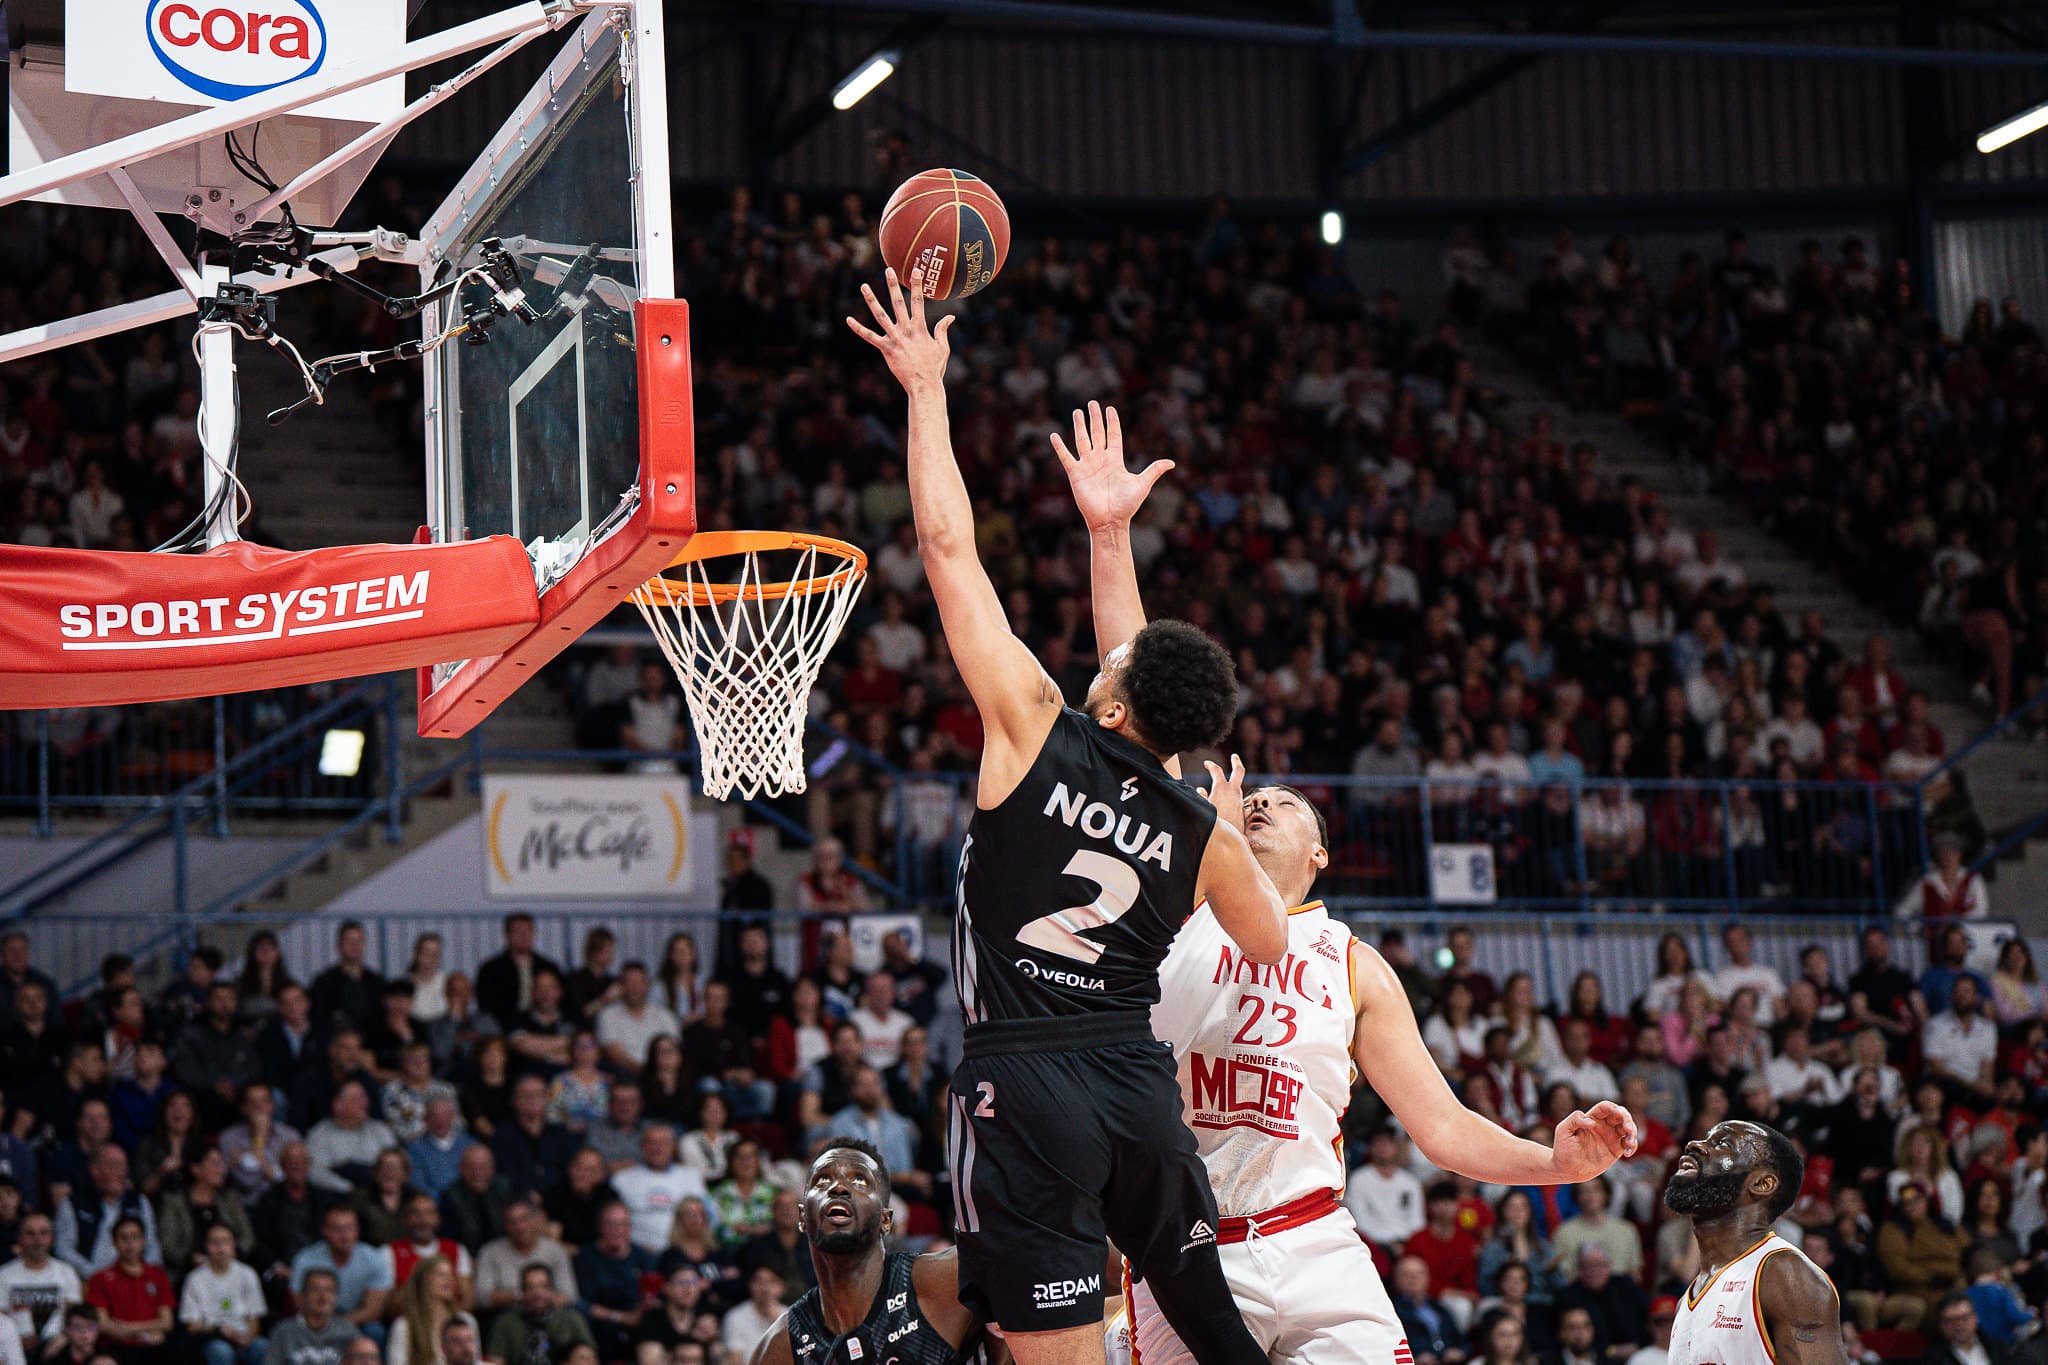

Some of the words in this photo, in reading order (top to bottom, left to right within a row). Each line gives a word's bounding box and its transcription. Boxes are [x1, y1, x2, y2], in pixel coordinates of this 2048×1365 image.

[159, 3, 311, 59] cora
[1043, 781, 1174, 873] NOUA
[1015, 849, 1141, 964] 2
[1041, 968, 1106, 991] VEOLIA
[1232, 994, 1298, 1047] 23
[1235, 1053, 1279, 1067] FONDÉE
[974, 1081, 996, 1118] 2
[1033, 1273, 1101, 1301] REPAM
[1036, 1298, 1077, 1309] assurances
